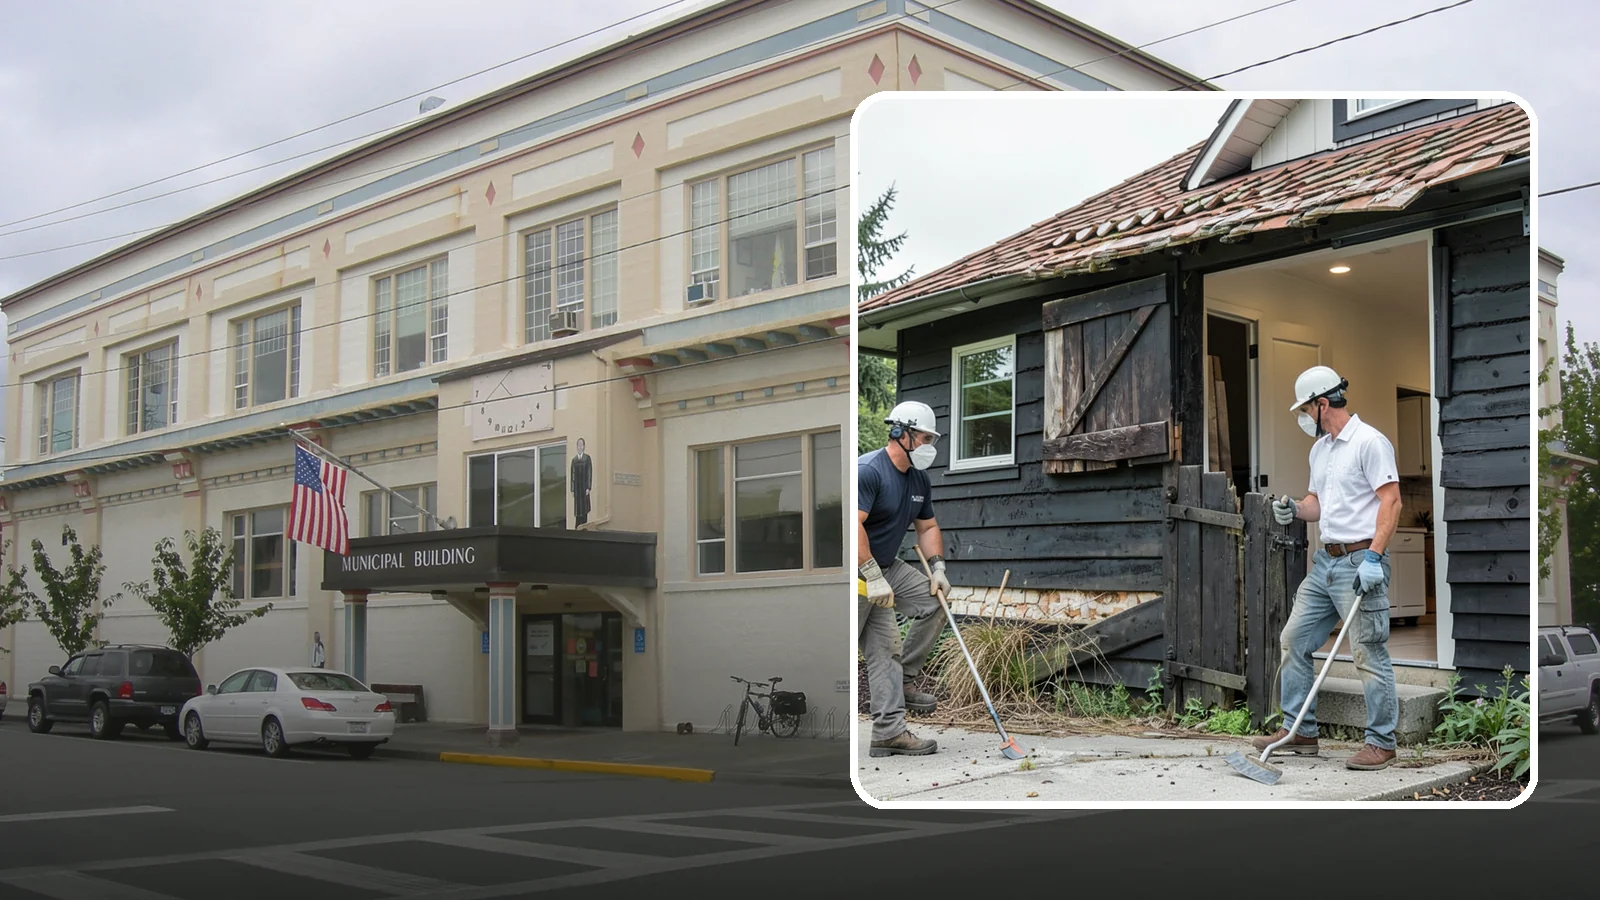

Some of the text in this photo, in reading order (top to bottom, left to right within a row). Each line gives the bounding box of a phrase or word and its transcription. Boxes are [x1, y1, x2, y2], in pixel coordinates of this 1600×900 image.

[536, 402, 540, 410] 4
[481, 407, 485, 415] 8
[488, 417, 492, 425] 9
[529, 414, 533, 422] 3
[507, 425, 513, 433] 12
[521, 420, 525, 428] 2
[342, 546, 475, 572] MUNICIPAL BUILDING
